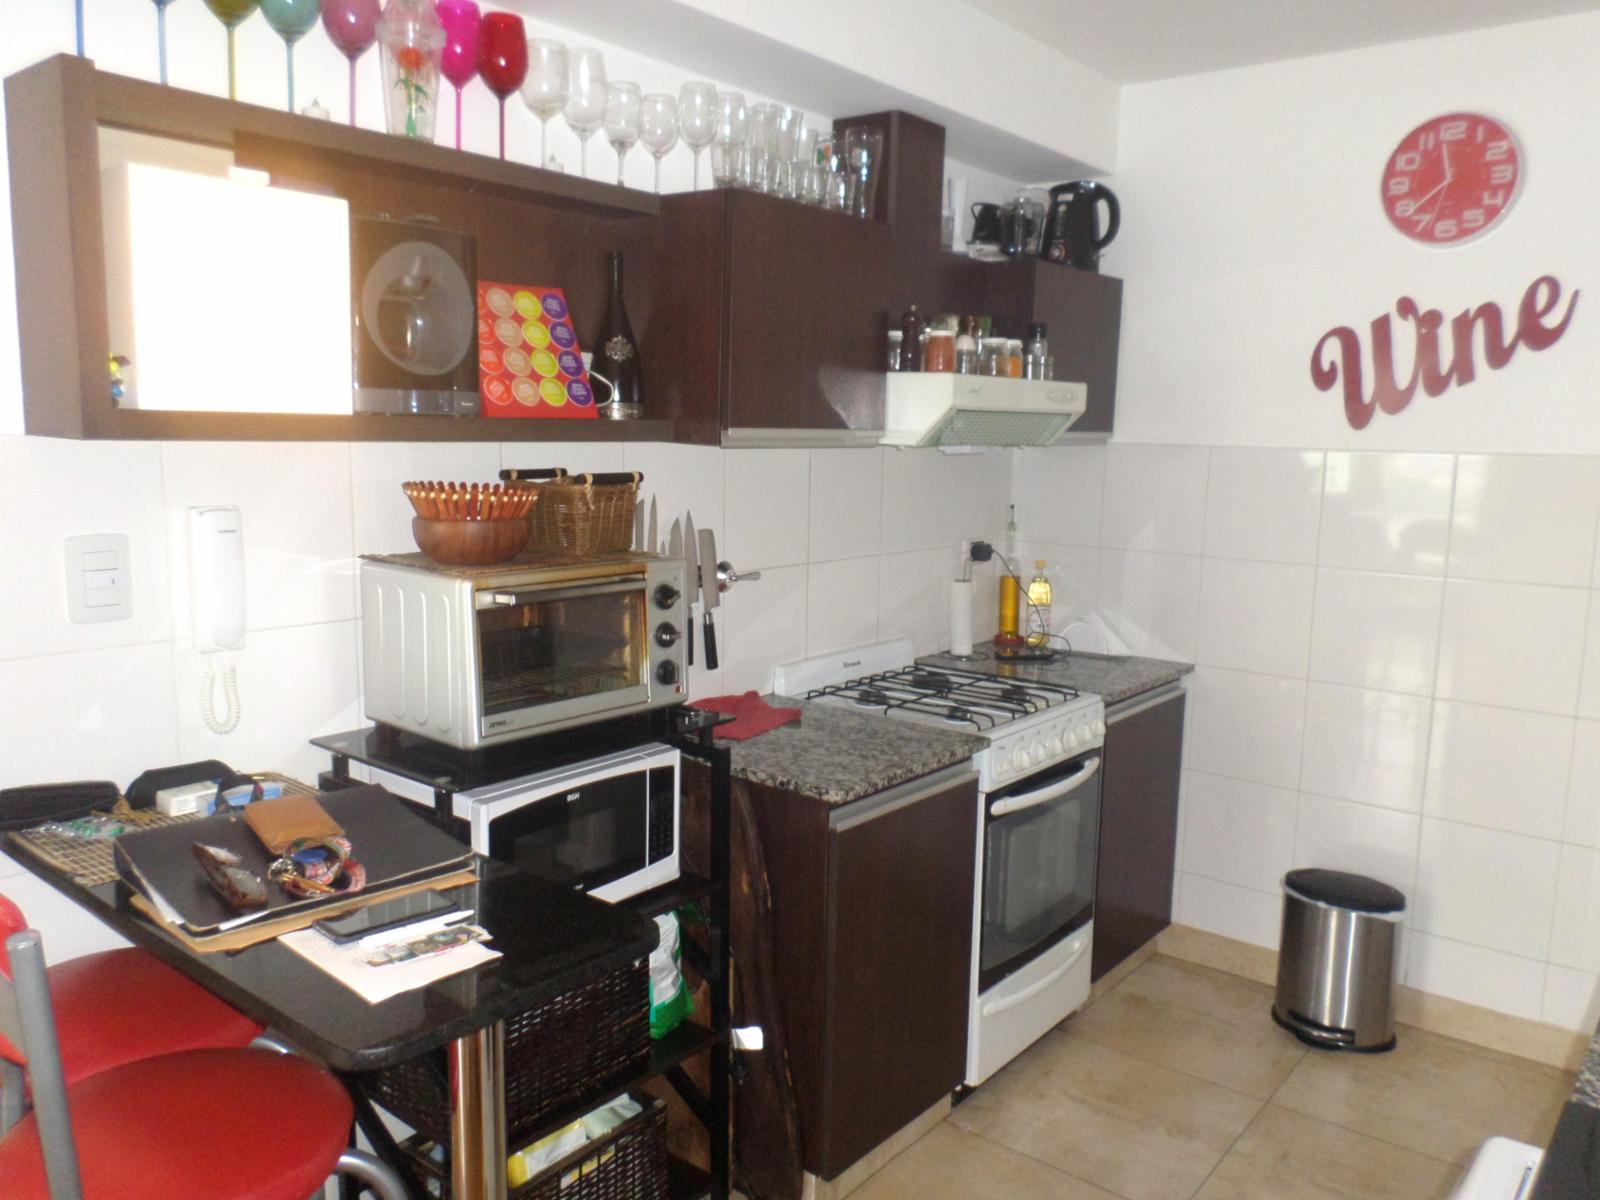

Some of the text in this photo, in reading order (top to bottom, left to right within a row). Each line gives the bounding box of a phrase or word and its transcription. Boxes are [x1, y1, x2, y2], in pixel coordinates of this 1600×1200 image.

[1418, 131, 1435, 151] 11
[1439, 121, 1467, 141] 12
[1475, 123, 1485, 144] 1
[1485, 140, 1509, 161] 2
[1395, 151, 1421, 172] 10
[1490, 164, 1513, 185] 3
[1388, 176, 1410, 195] 9
[1395, 199, 1417, 217] 8
[1482, 189, 1504, 207] 4
[1411, 213, 1432, 233] 7
[1462, 208, 1484, 228] 5
[1434, 219, 1457, 239] 6
[1310, 275, 1580, 430] Wine
